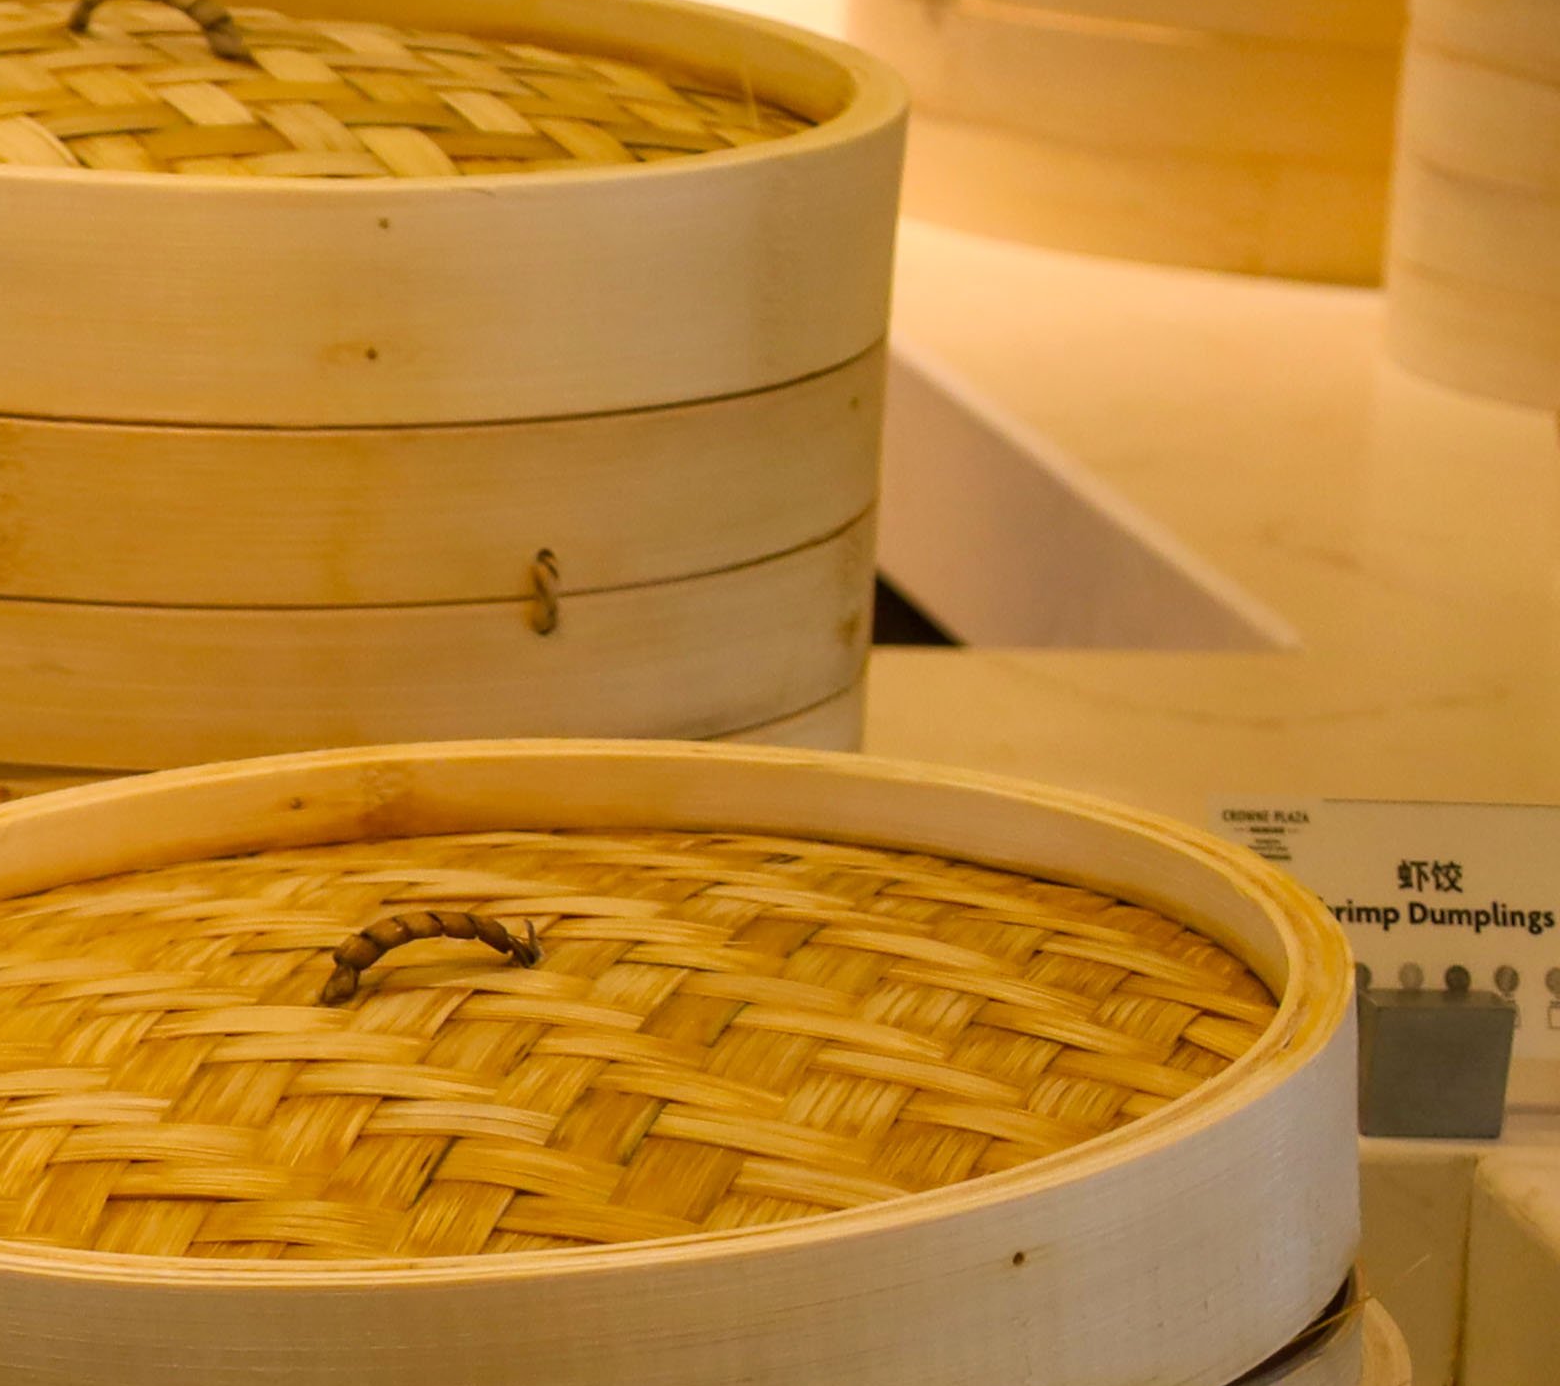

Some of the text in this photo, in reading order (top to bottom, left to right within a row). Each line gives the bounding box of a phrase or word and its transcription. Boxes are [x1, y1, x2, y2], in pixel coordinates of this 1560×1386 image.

[1397, 859, 1463, 893] 虾饺
[1327, 899, 1555, 935] rimp Dumplings
